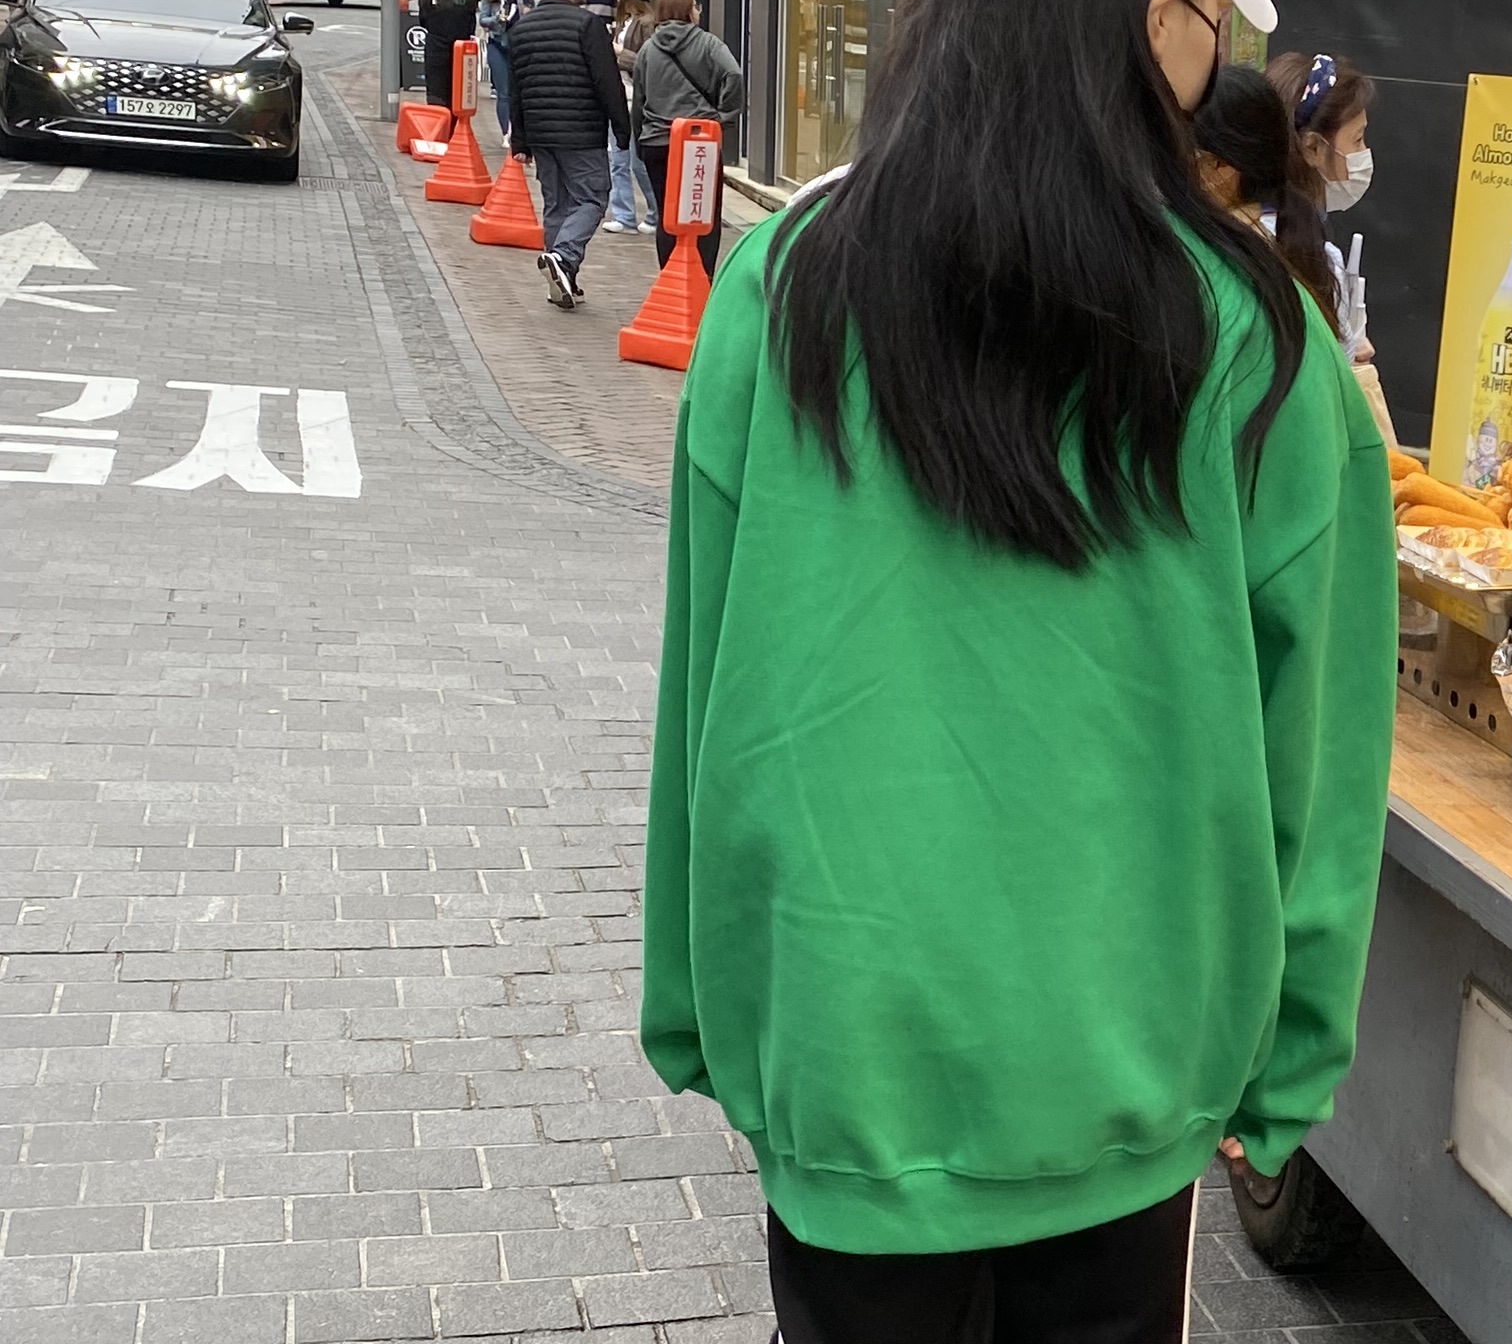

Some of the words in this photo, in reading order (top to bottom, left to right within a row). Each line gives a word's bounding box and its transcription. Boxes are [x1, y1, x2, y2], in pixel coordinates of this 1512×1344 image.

[119, 98, 154, 113] 157오
[158, 101, 193, 116] 2297
[689, 146, 707, 219] 주차금지
